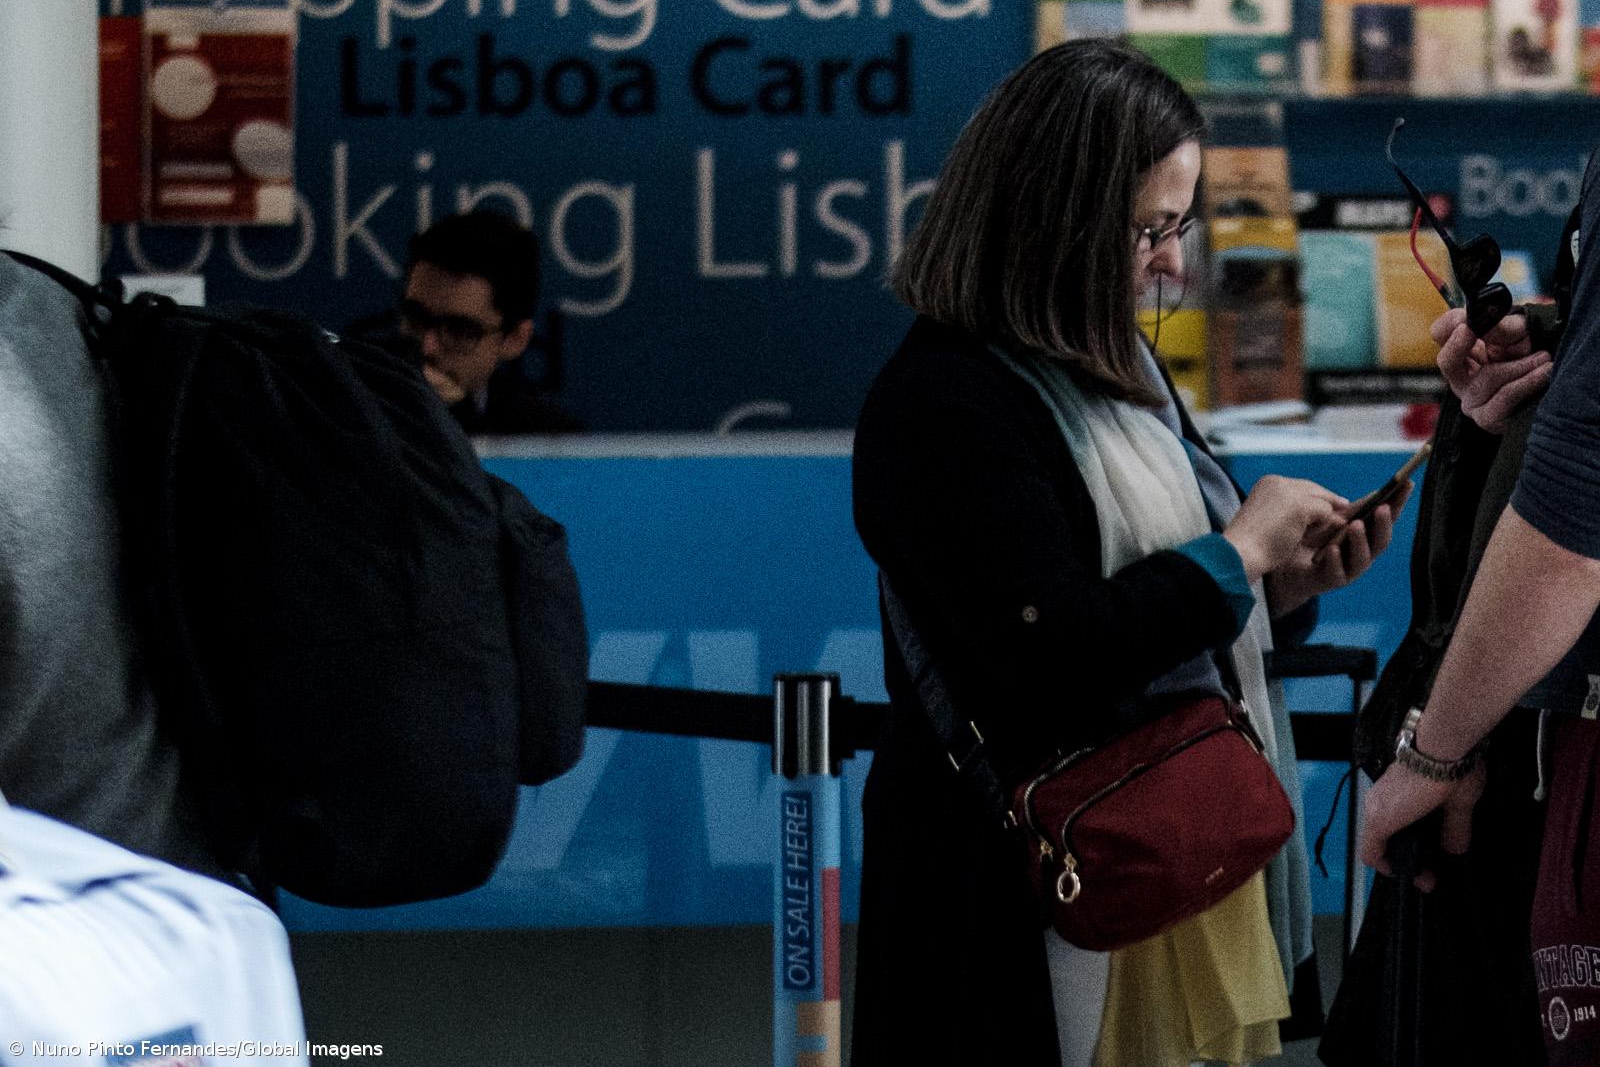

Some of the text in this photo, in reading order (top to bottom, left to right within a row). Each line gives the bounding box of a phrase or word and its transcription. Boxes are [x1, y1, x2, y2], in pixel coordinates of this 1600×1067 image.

[340, 34, 913, 119] Lisboa Card
[1460, 152, 1588, 218] Boo
[784, 794, 812, 988] ON SALE HERE!
[1573, 1005, 1597, 1022] 1914
